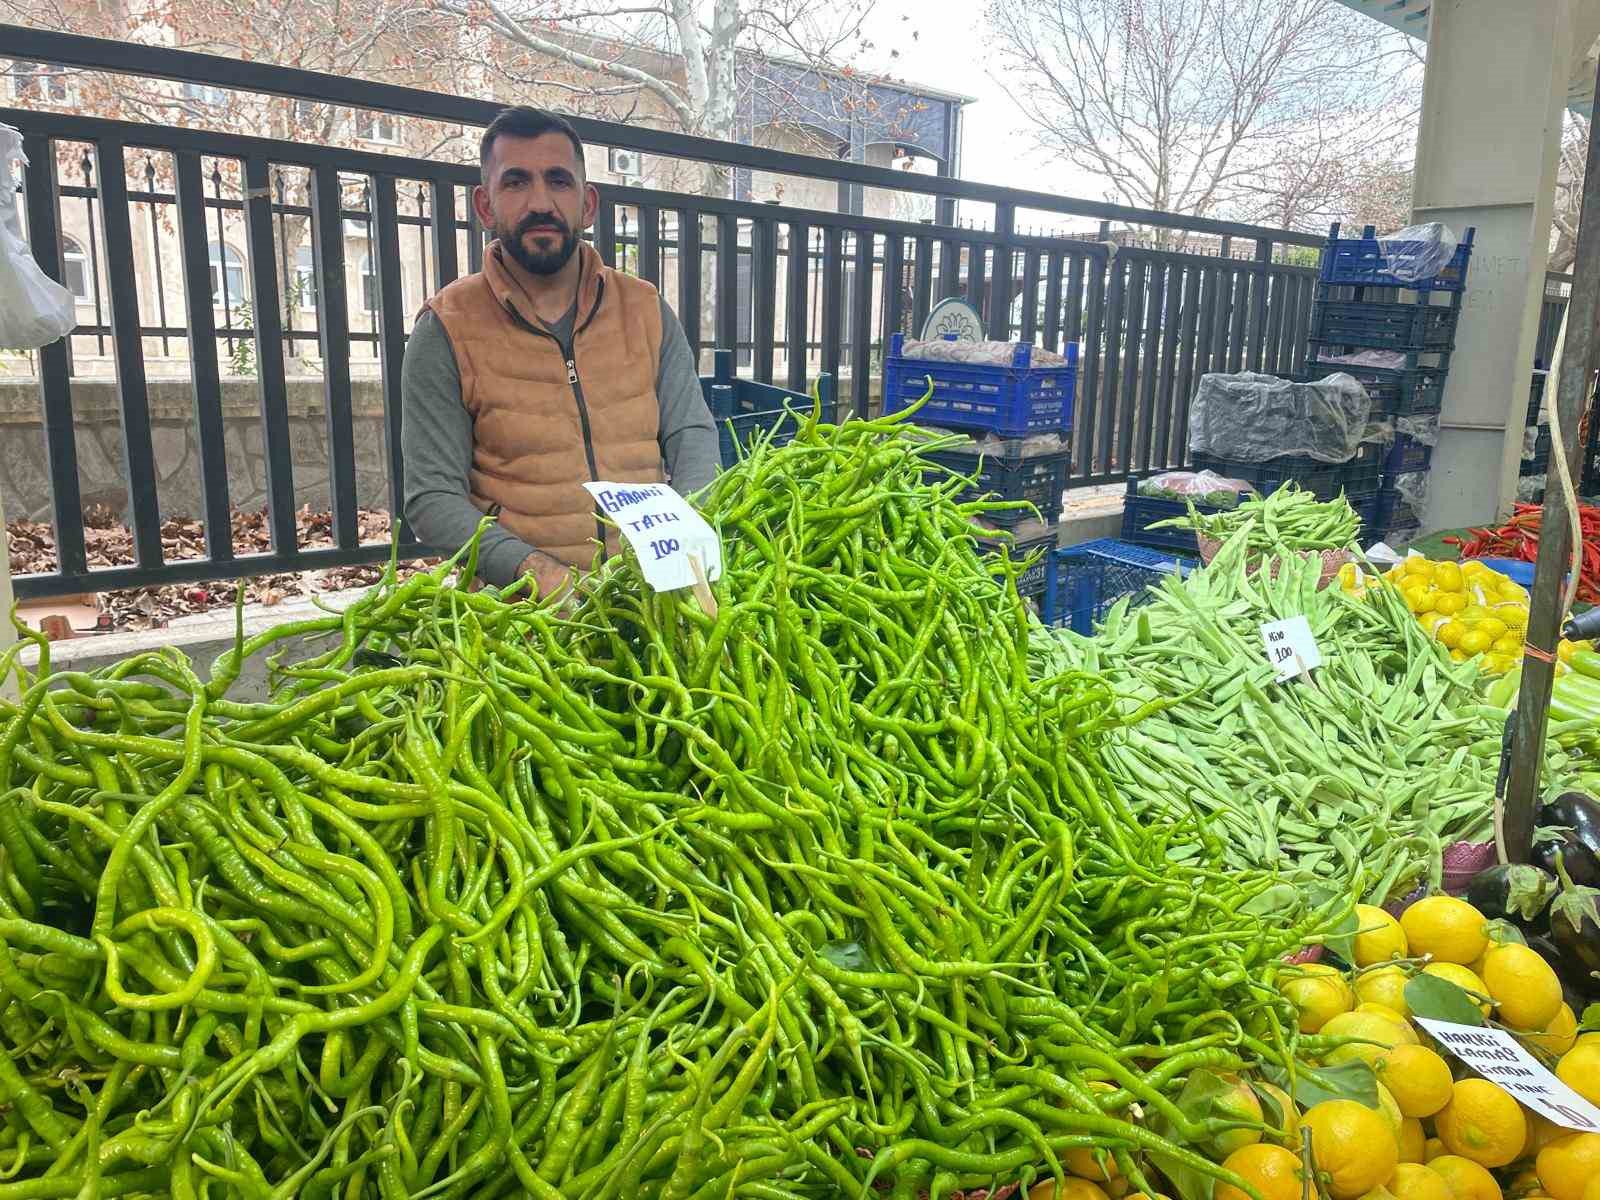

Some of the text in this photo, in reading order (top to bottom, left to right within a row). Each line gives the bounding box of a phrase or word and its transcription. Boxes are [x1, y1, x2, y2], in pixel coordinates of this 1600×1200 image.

[629, 512, 680, 532] TATLI
[650, 538, 680, 560] 100
[1275, 646, 1293, 663] 100
[1498, 1081, 1553, 1096] TANE
